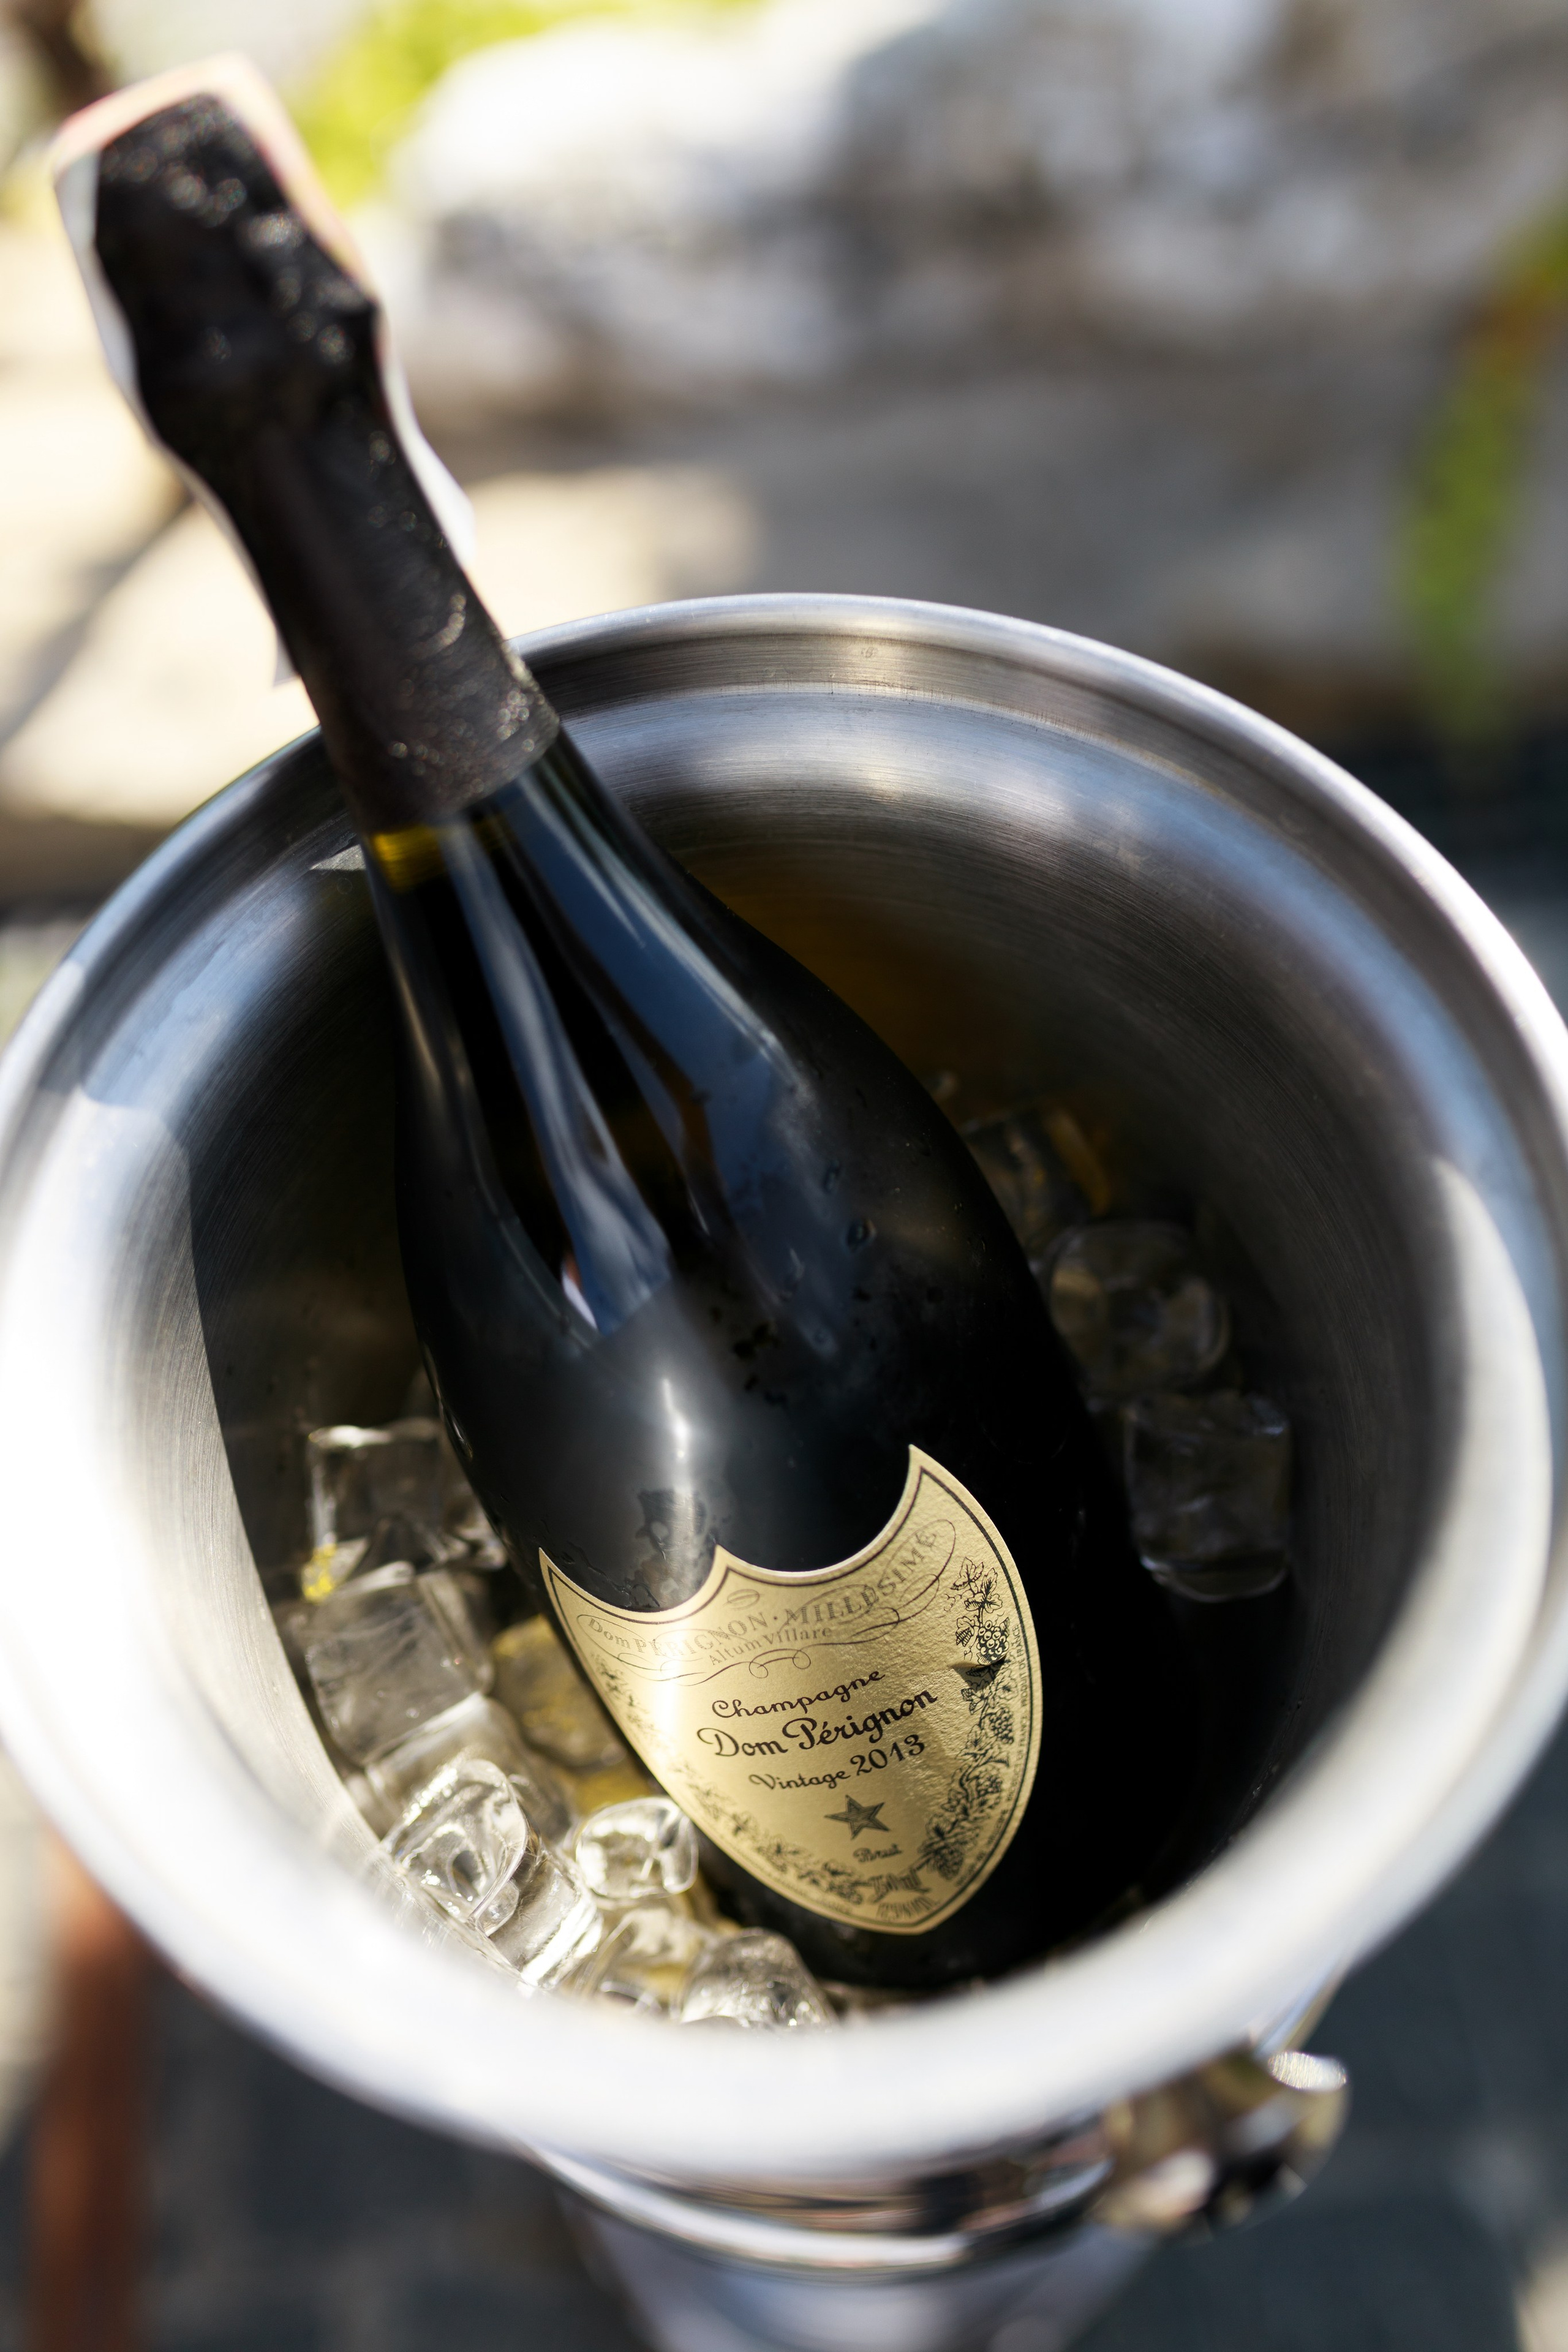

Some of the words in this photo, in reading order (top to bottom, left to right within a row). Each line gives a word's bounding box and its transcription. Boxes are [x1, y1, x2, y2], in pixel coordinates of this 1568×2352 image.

[588, 1617, 631, 1649] Dom
[1012, 1624, 1025, 1657] FRANCE
[712, 1671, 886, 1718] Champagne
[696, 1727, 788, 1757] Dom
[782, 1690, 938, 1750] Pérignon
[748, 1770, 851, 1790] Vintage
[850, 1733, 926, 1776] 2013
